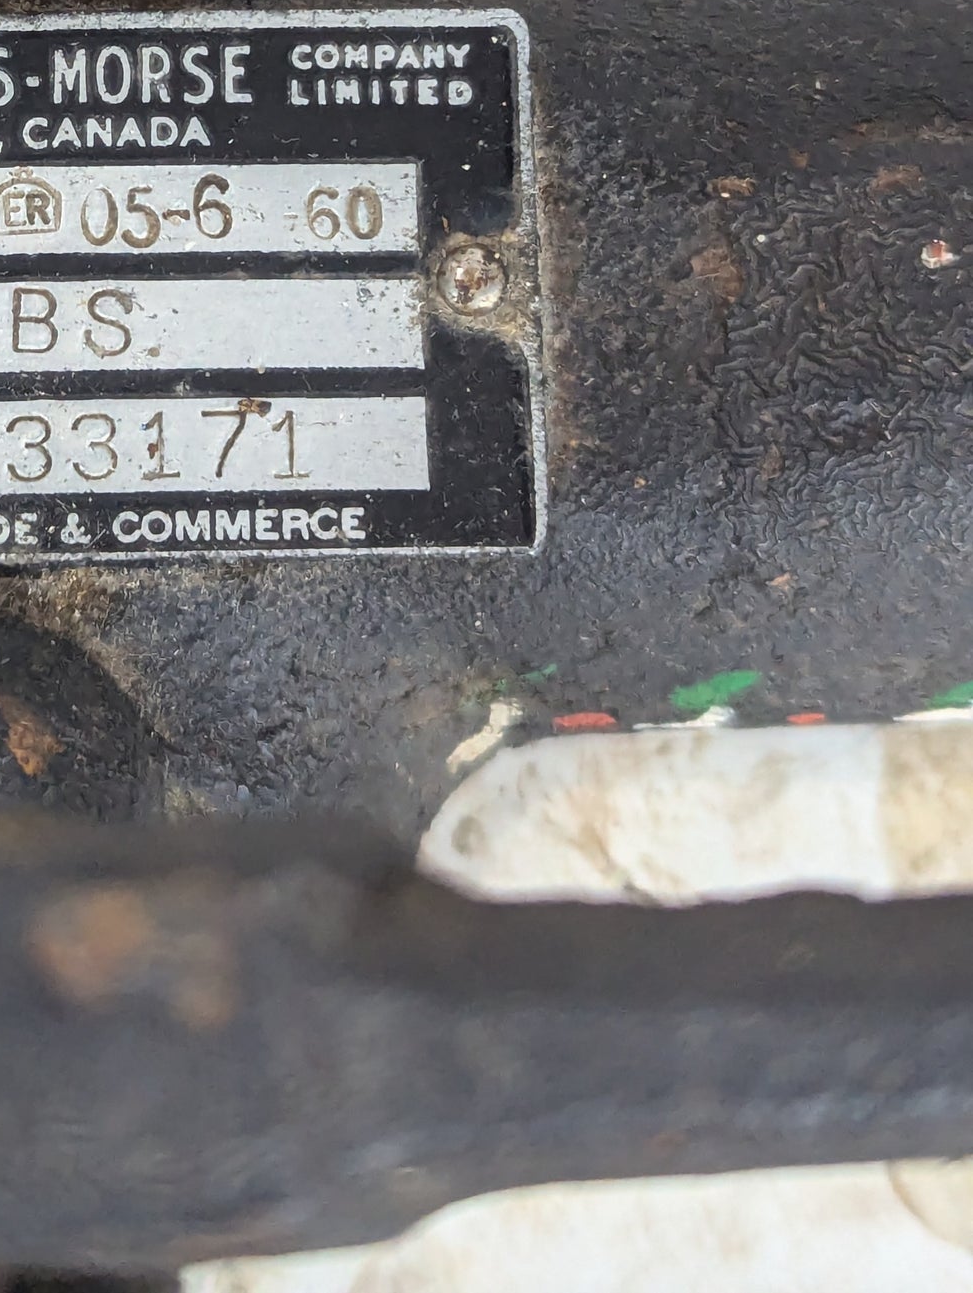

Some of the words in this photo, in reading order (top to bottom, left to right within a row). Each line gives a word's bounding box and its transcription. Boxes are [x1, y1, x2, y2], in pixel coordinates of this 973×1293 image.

[290, 43, 472, 72] COMPANY
[290, 77, 474, 107] LIMITED
[22, 116, 213, 150] CANADA
[4, 410, 311, 483] 33171
[60, 512, 94, 546] &
[112, 506, 368, 545] COMMERCE
